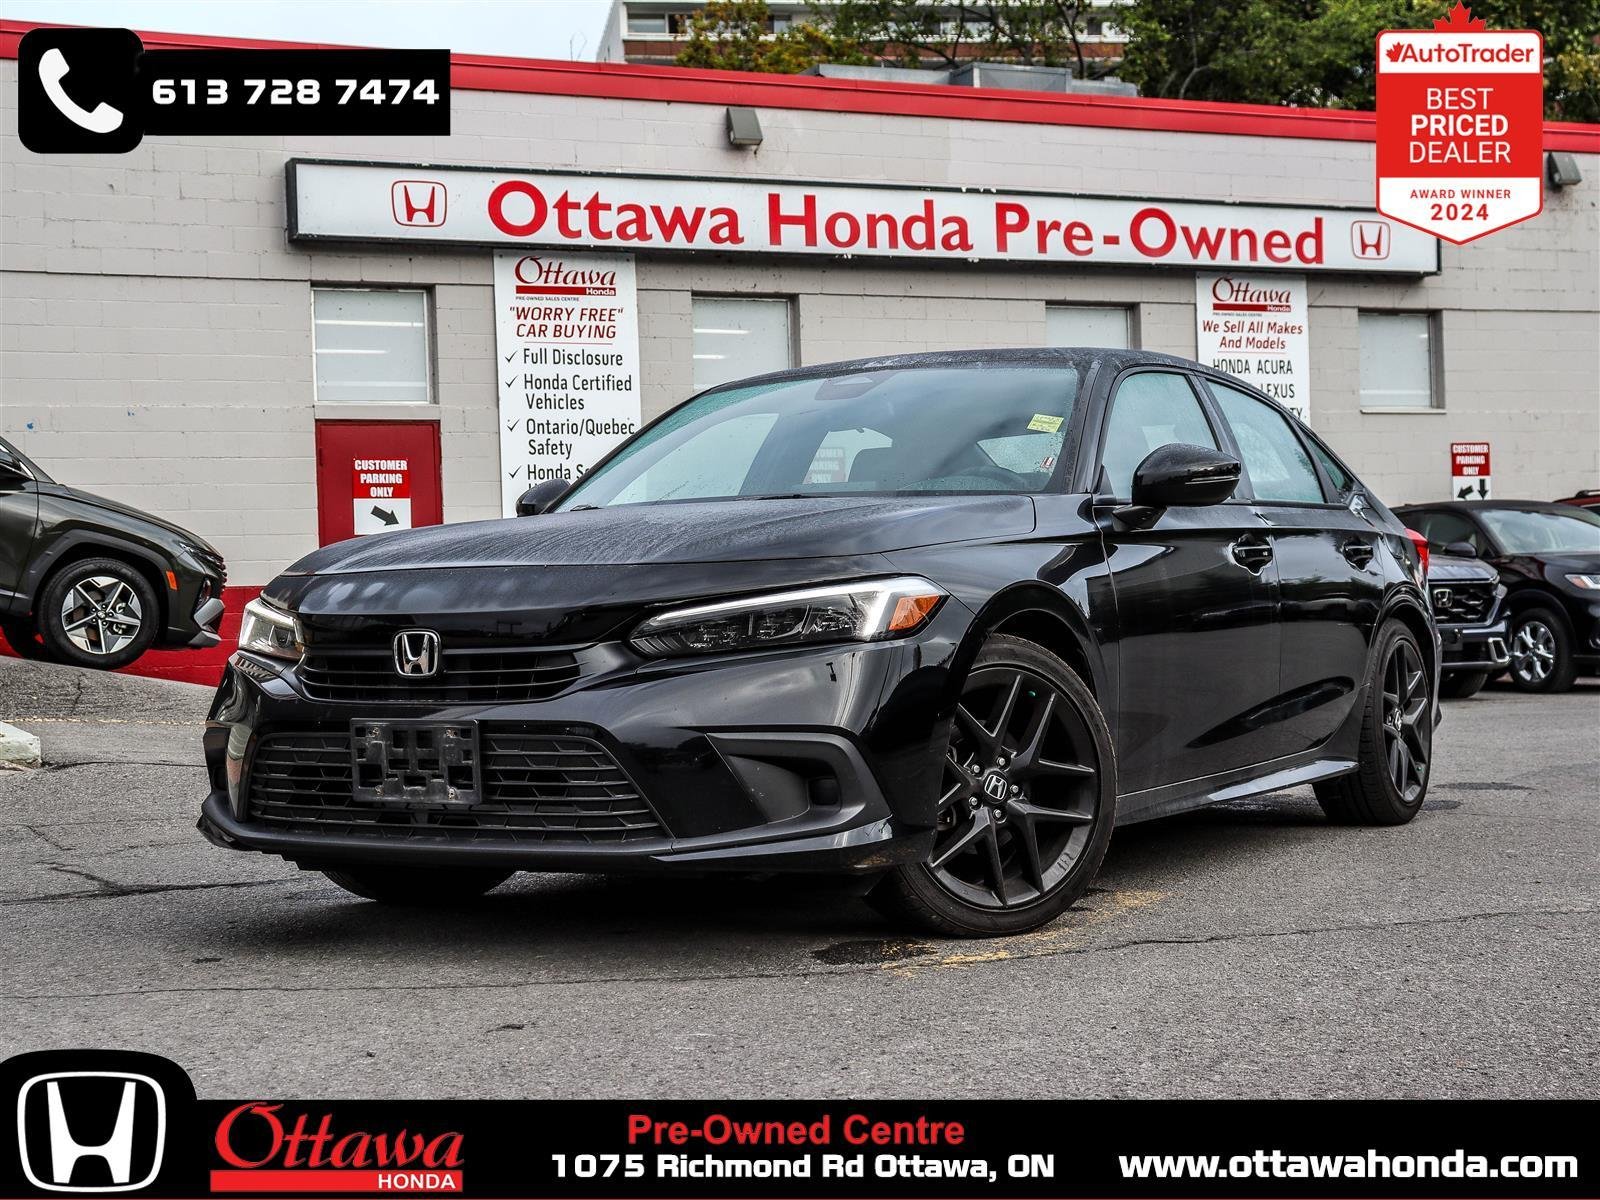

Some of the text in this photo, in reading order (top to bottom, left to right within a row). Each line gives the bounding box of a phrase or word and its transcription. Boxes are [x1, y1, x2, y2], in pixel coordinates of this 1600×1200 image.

[487, 180, 1324, 264] Ottawa Honda Pre-Owned
[515, 255, 617, 286] Ottawa
[586, 287, 615, 296] Honda
[1212, 276, 1291, 303] Ottawa
[510, 306, 624, 323] "WORRY FREE"
[516, 323, 617, 339] CAR BUYING
[1203, 320, 1303, 335] We Sell All Makes
[1219, 336, 1286, 350] And Models
[523, 348, 623, 366] Full Disclosure
[1212, 359, 1293, 375] HONDA ACURA
[524, 373, 632, 391] Honda Certified
[526, 393, 585, 410] Vehicles
[526, 418, 635, 437] Ontario/Quebec
[528, 439, 573, 460] Safety
[354, 459, 408, 471] CUSTOMER
[527, 463, 571, 480] Honda
[360, 473, 403, 484] PARKING
[370, 486, 394, 497] ONLY
